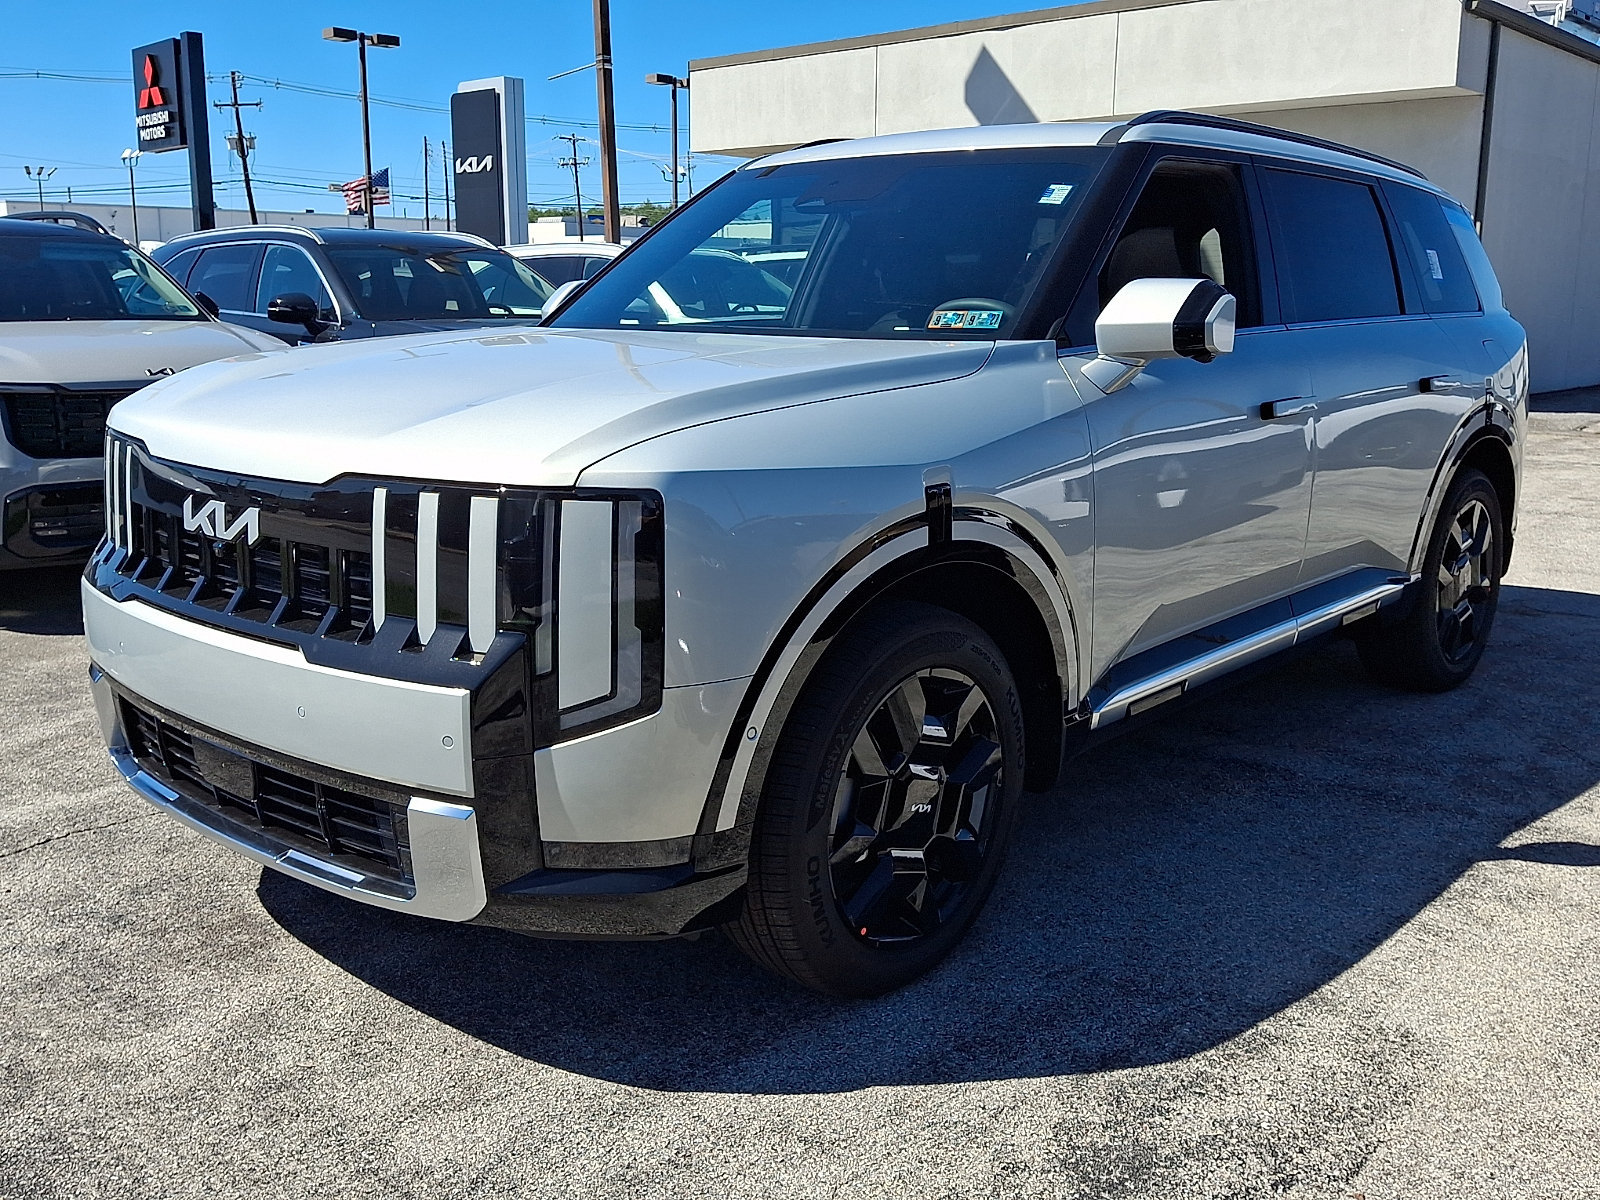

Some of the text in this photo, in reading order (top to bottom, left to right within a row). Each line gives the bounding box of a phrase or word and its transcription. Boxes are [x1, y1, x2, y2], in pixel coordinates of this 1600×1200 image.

[136, 110, 169, 128] MITSUBISHI
[140, 125, 166, 141] MOTORS
[455, 154, 493, 174] KIA
[183, 494, 260, 546] KIA
[806, 855, 834, 949] KUMHO
